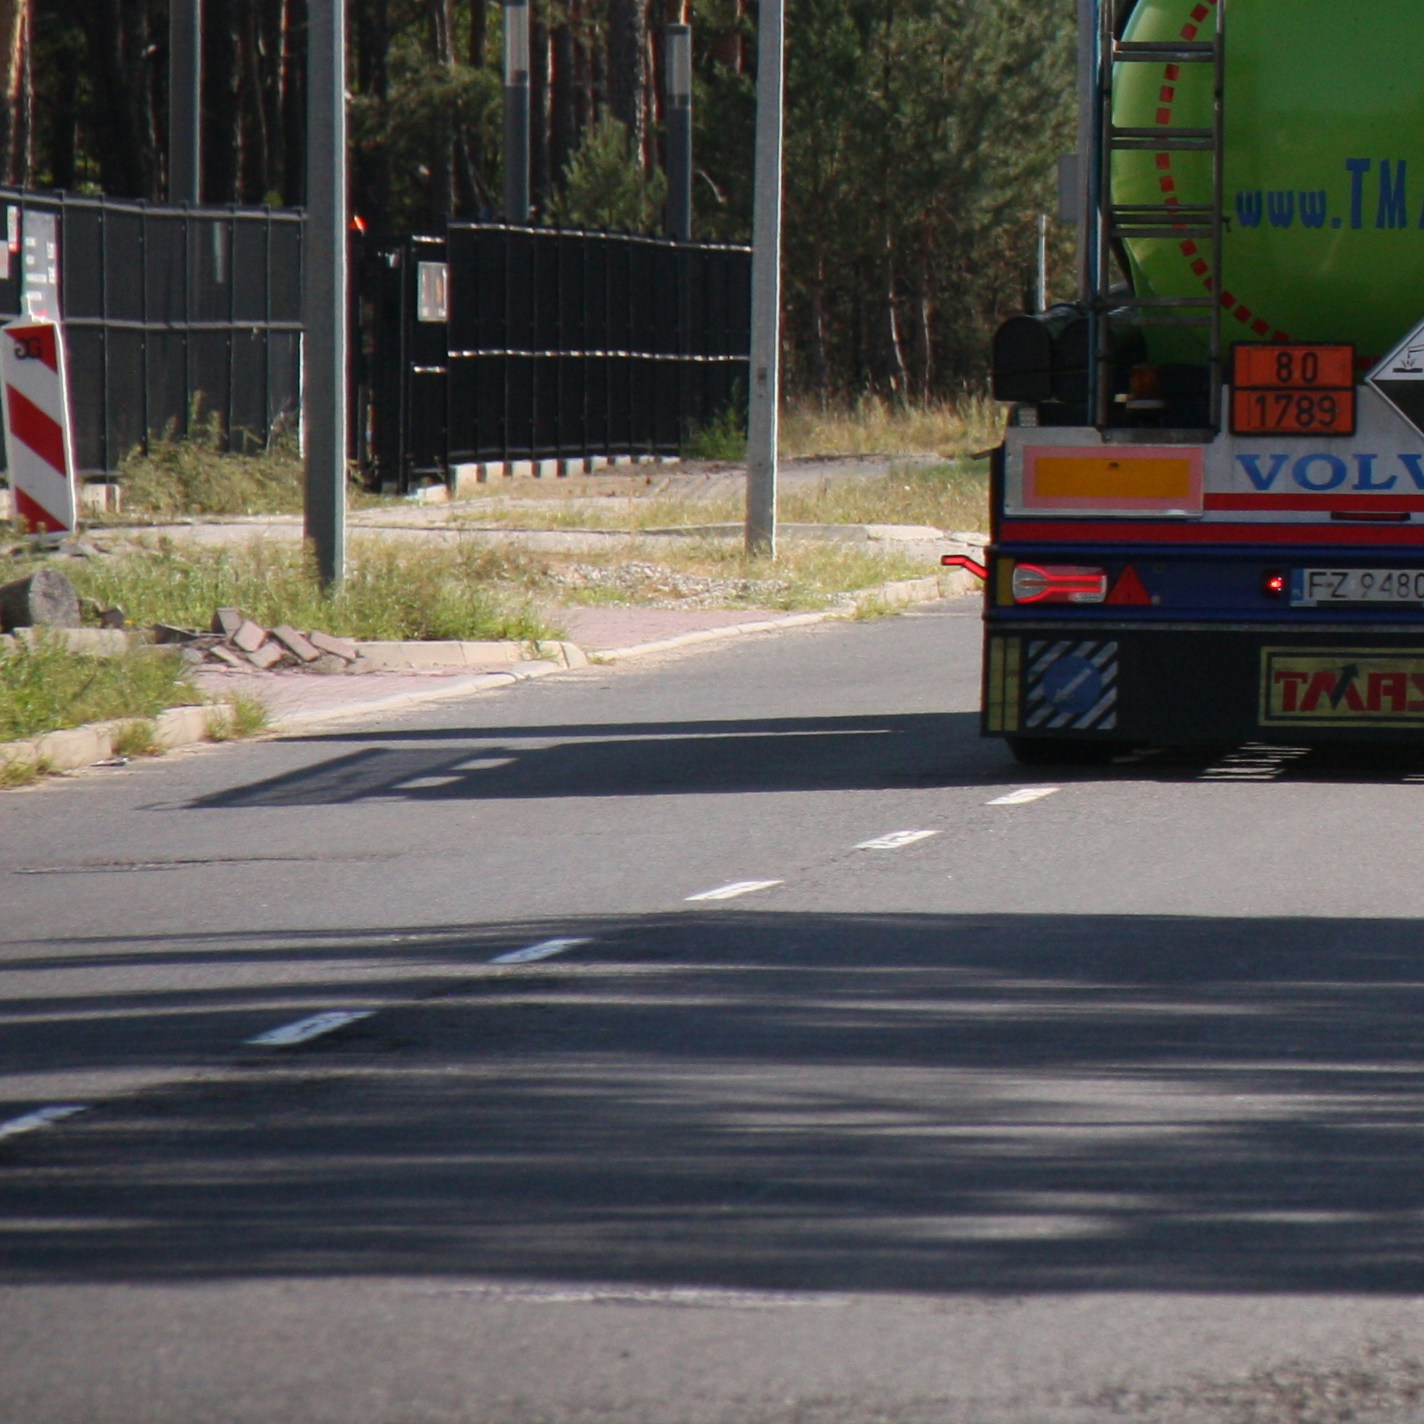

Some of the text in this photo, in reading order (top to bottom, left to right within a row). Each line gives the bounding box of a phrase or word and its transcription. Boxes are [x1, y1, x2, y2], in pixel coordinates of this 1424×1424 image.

[1275, 351, 1319, 384] 80
[1254, 393, 1338, 427] 1789
[1308, 572, 1348, 598] FZ
